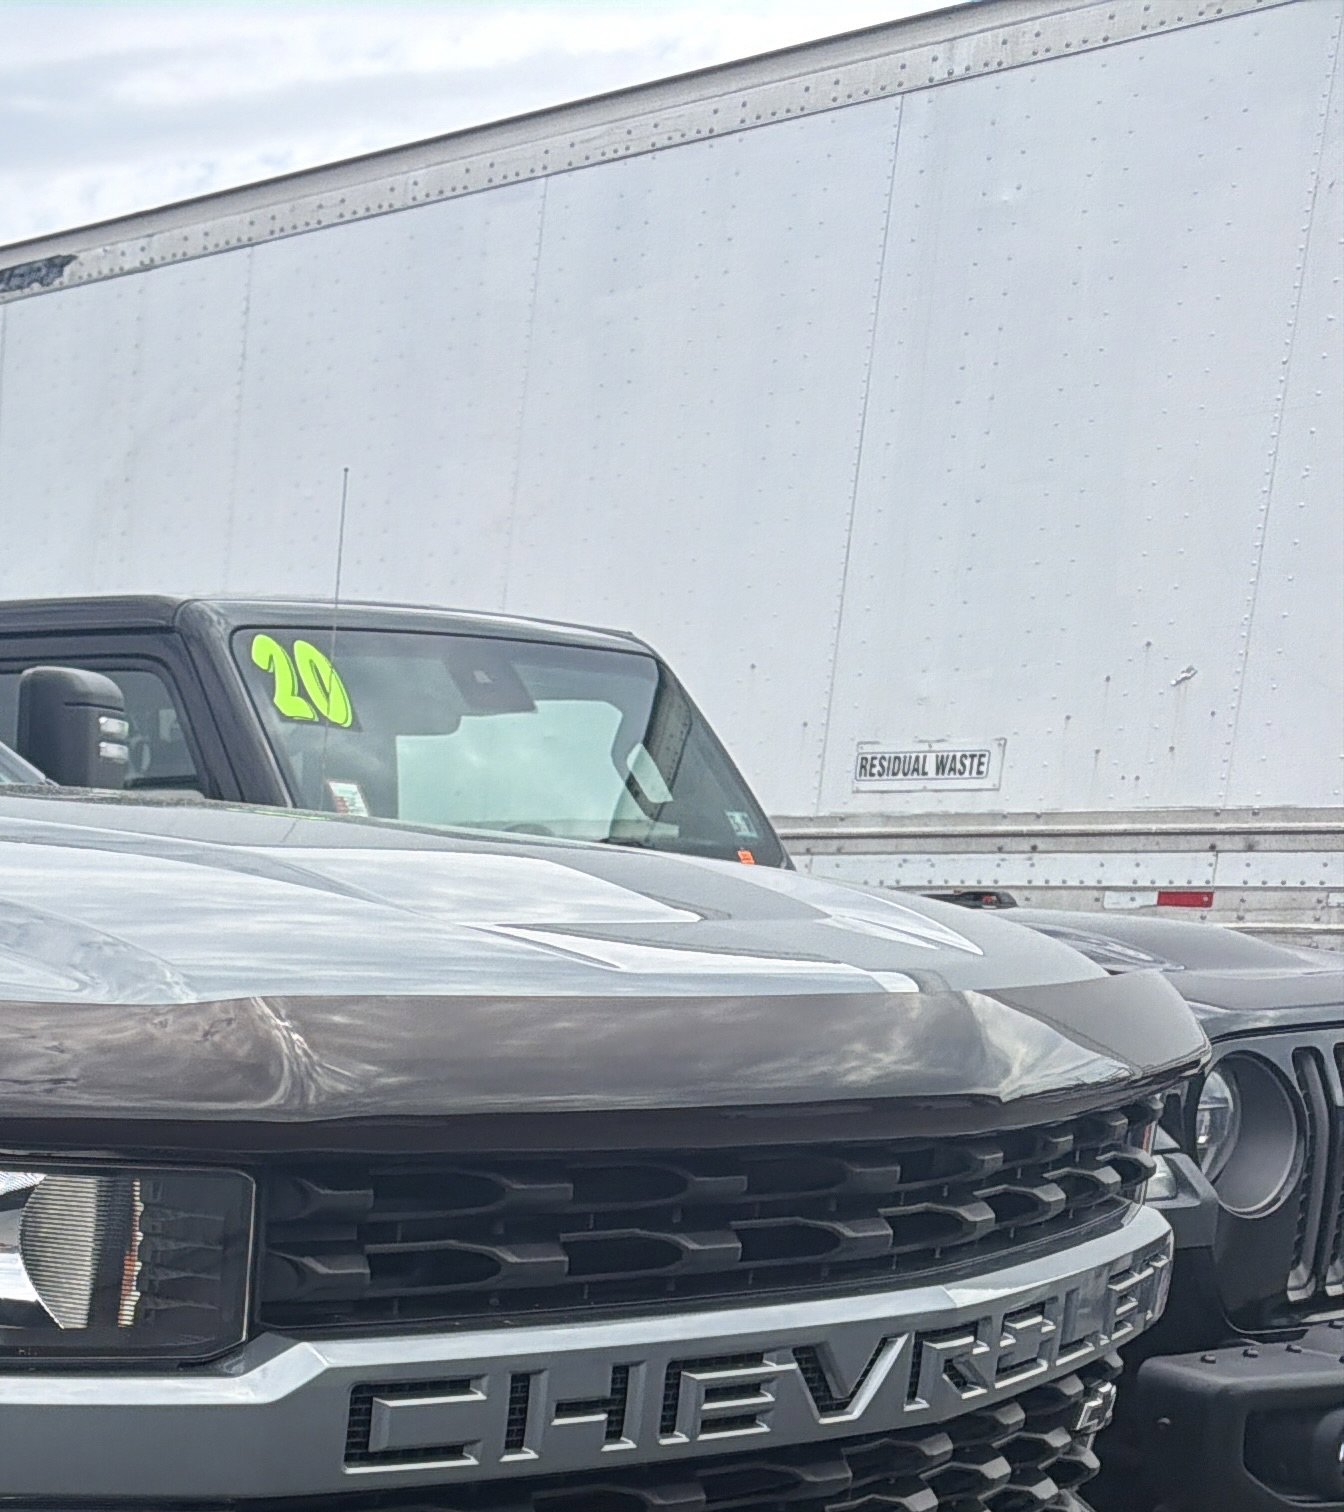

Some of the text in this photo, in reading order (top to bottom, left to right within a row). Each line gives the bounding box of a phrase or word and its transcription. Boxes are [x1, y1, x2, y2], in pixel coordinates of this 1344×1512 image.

[251, 634, 353, 728] 20
[858, 753, 987, 778] RESIDUAL WASTE
[342, 1250, 1170, 1475] CHEVROLET
